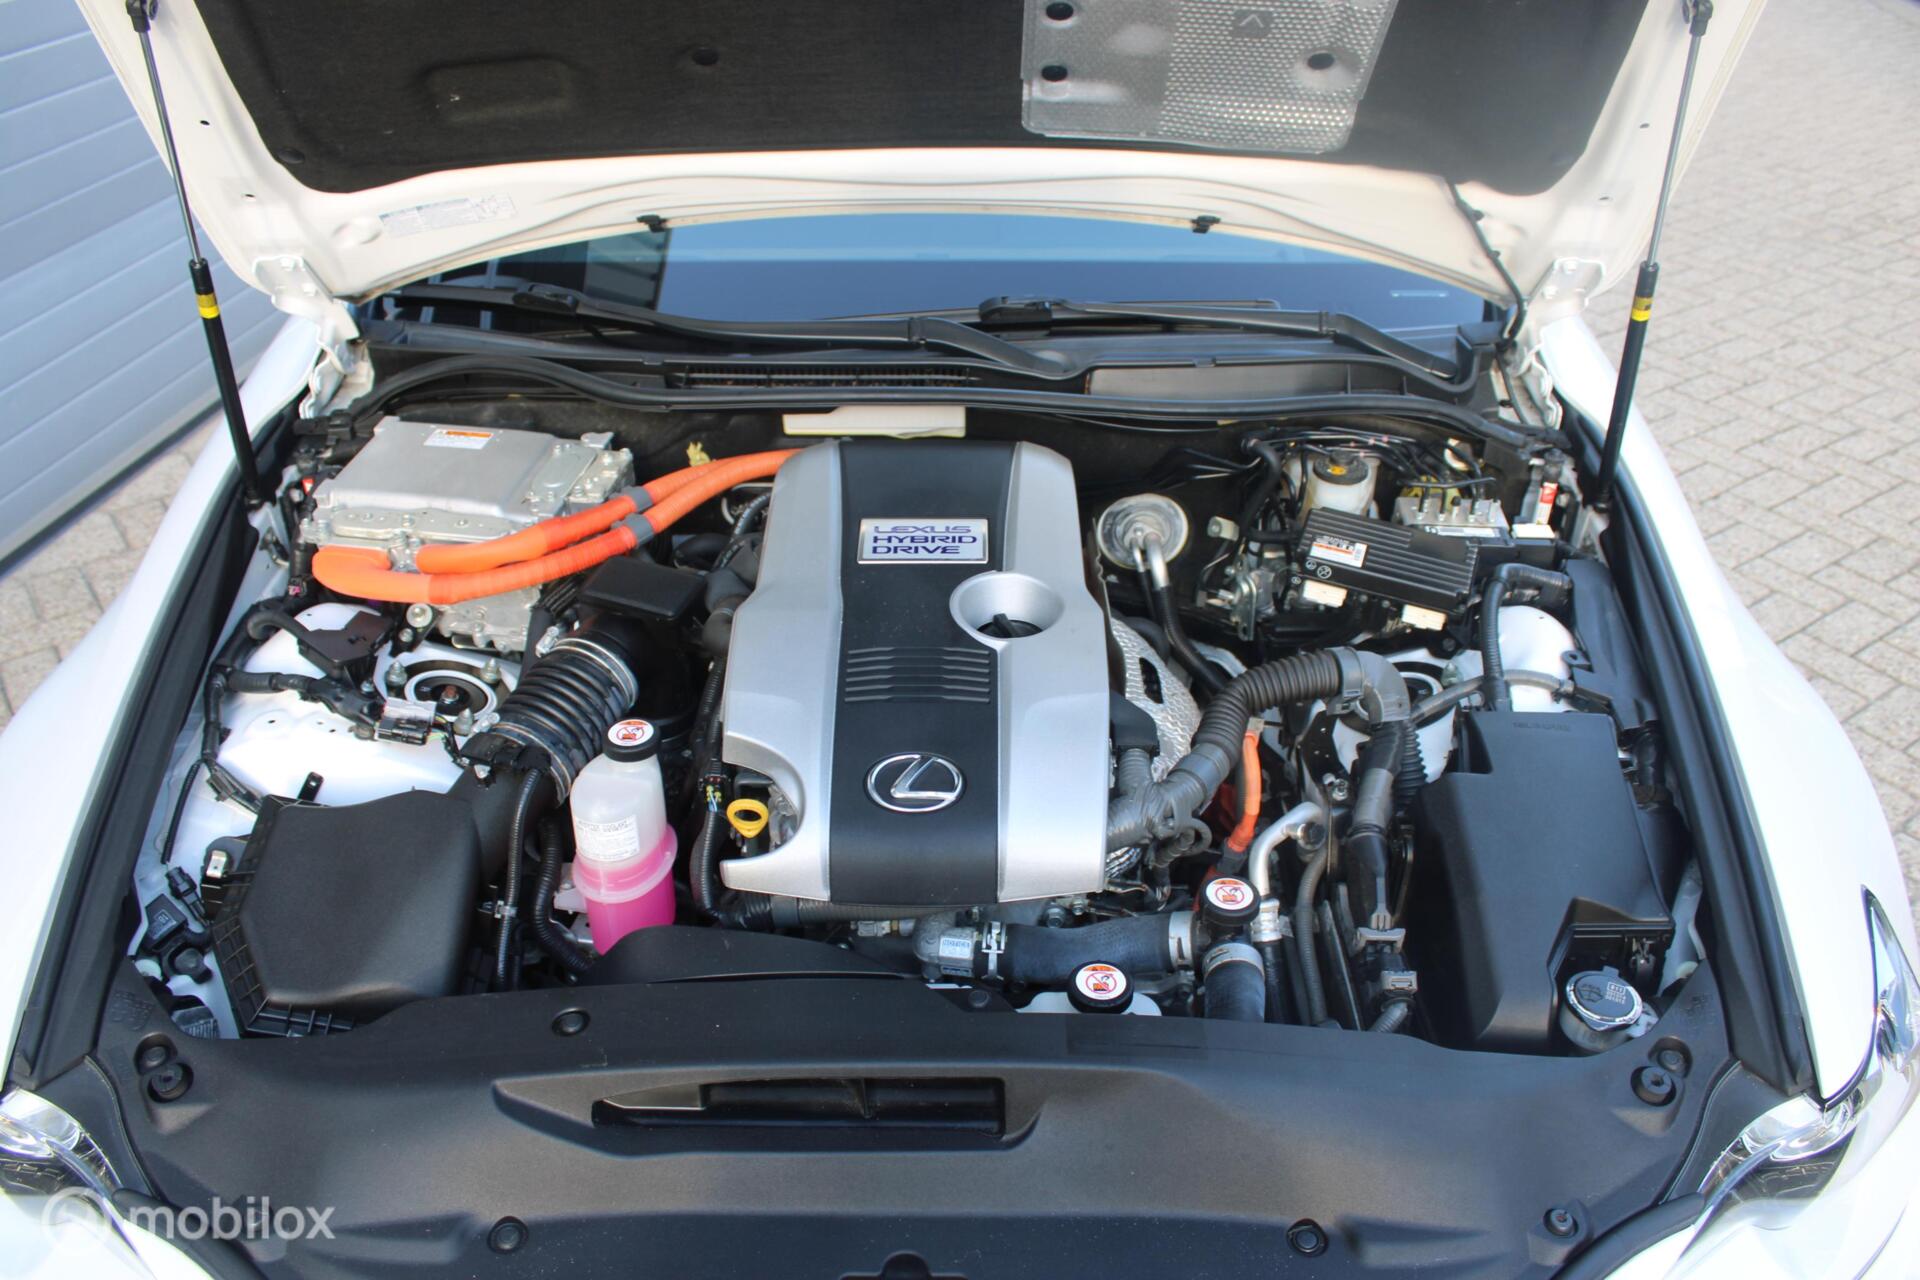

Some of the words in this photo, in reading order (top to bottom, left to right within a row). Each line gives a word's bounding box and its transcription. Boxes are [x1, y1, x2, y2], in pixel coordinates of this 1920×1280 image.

[874, 525, 972, 534] LEXUS
[873, 535, 978, 544] HYBRID
[871, 545, 960, 554] DRIVE
